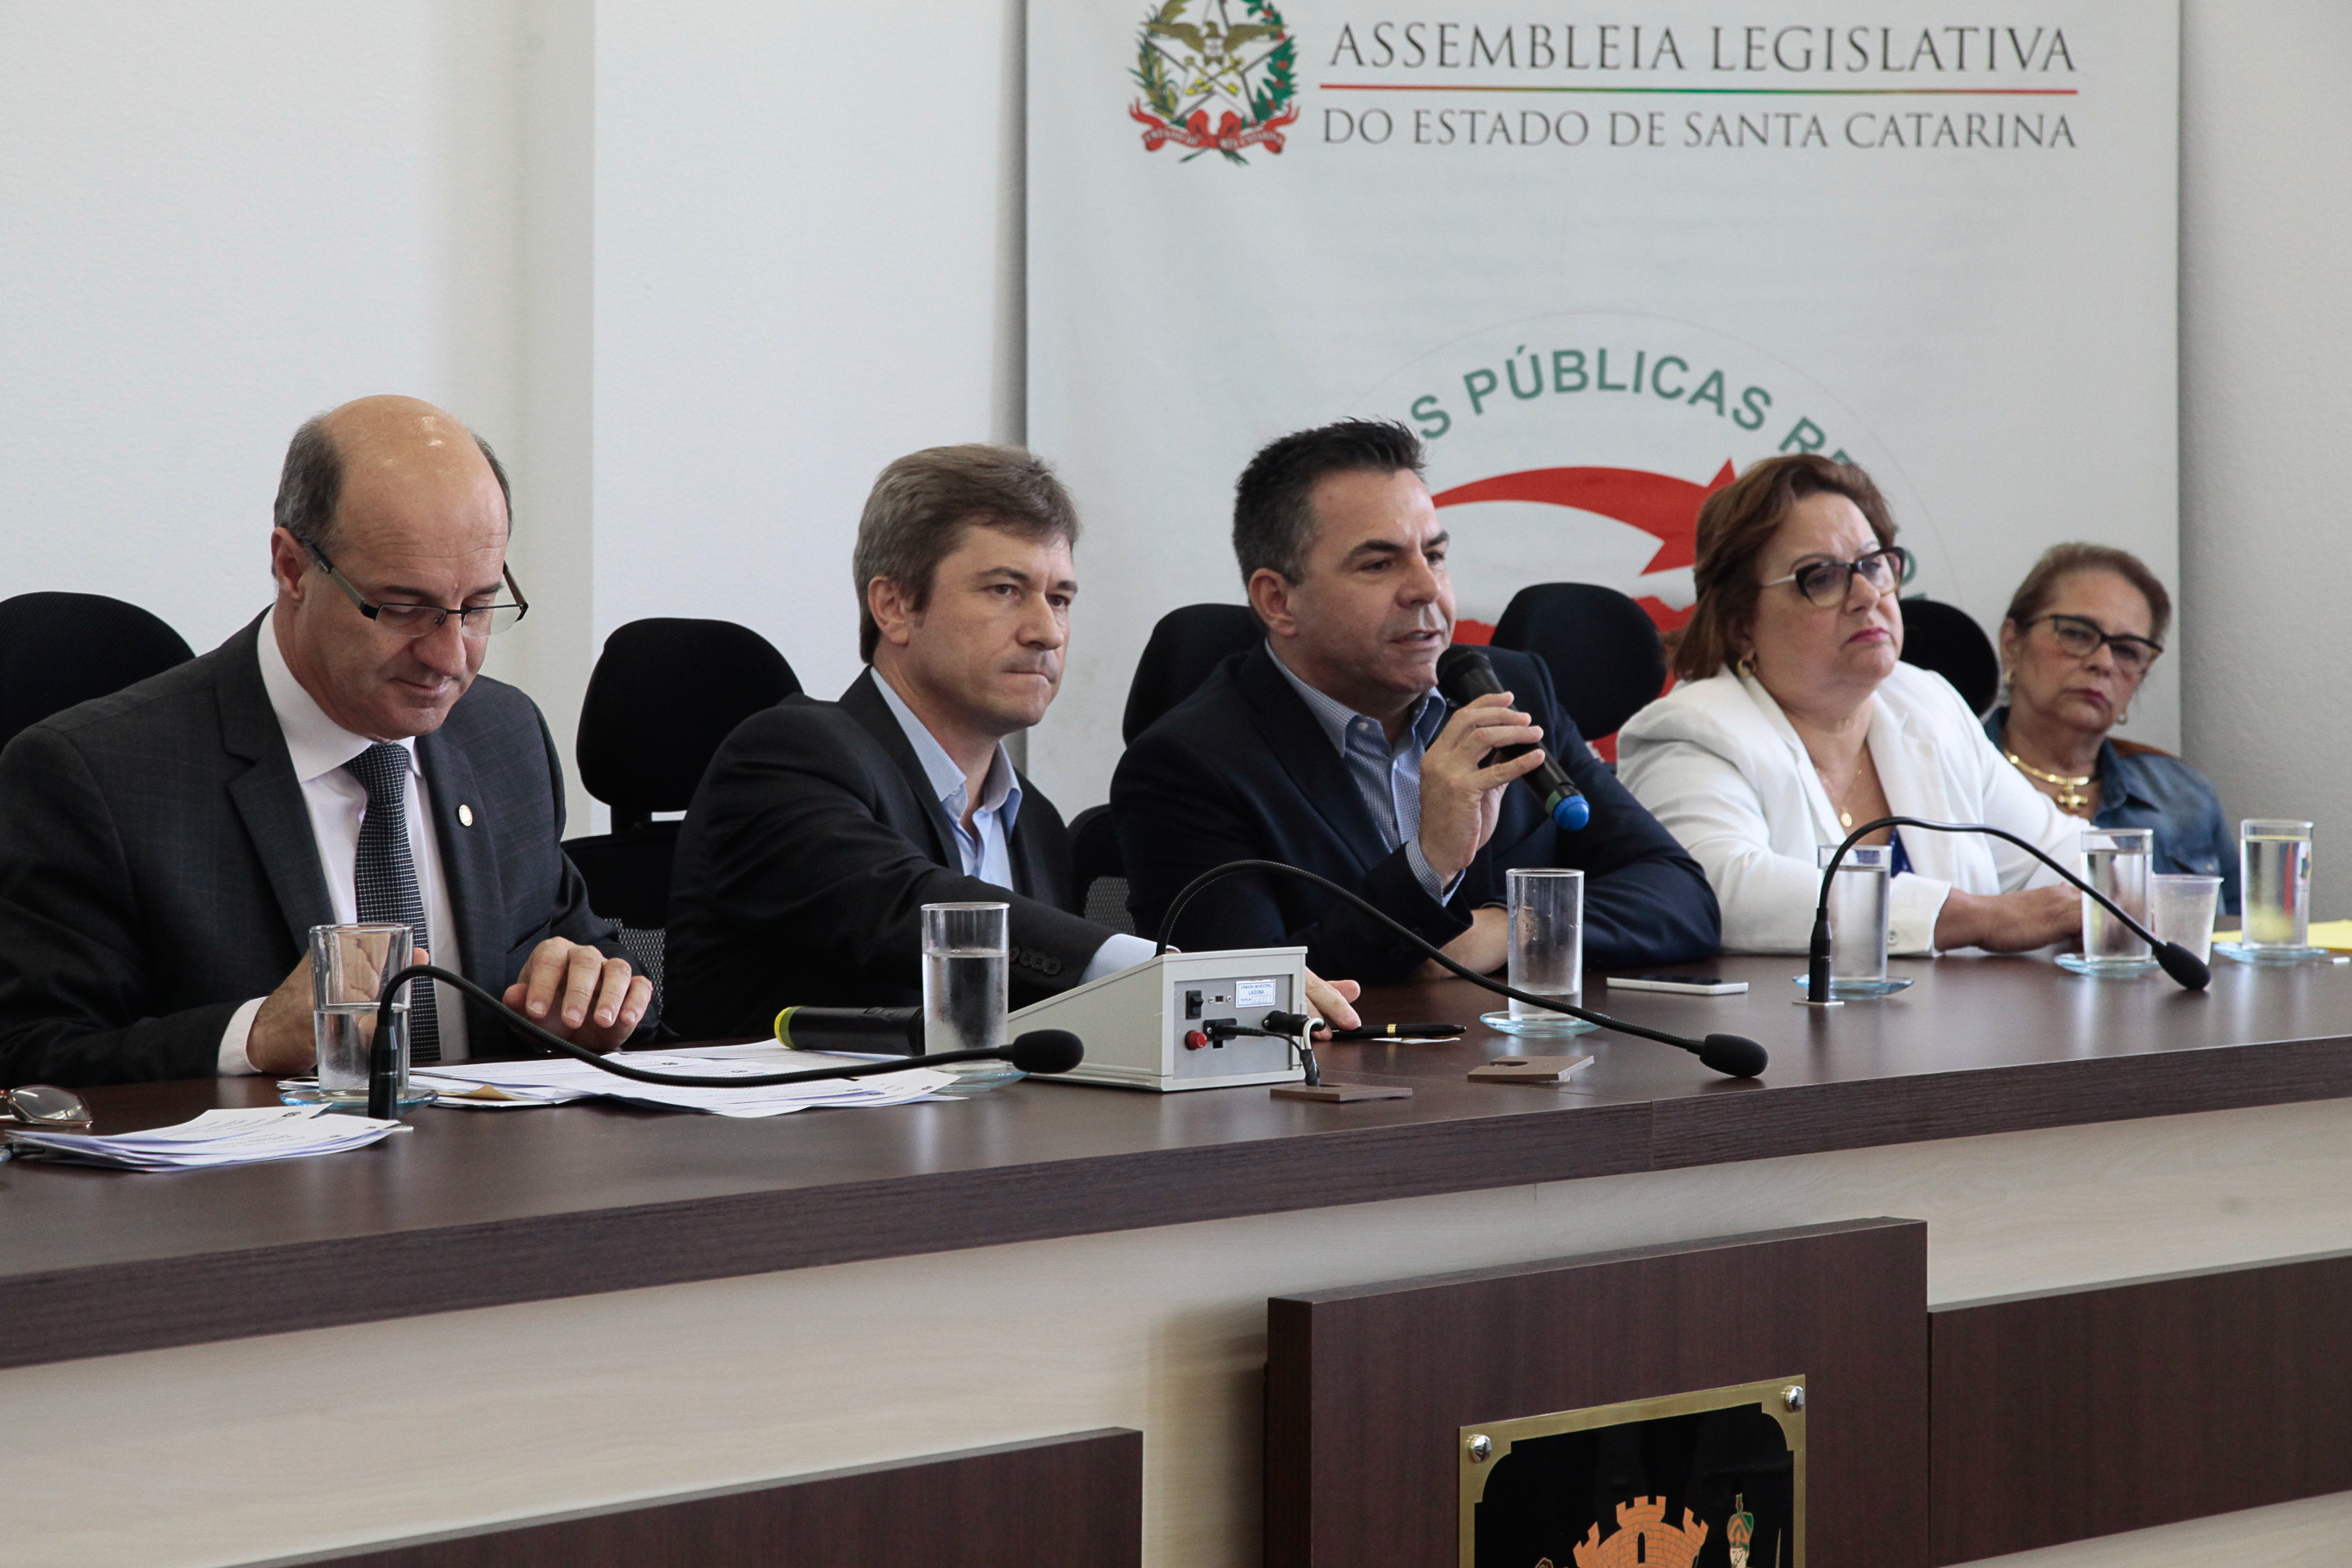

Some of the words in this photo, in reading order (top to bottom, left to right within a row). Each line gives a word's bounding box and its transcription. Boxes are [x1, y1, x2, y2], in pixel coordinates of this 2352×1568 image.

[1328, 22, 1685, 70] ASSEMBLEIA
[1710, 25, 2078, 72] LEGISLATIVA
[1323, 108, 1393, 145] DO
[1414, 109, 1591, 146] ESTADO
[1609, 111, 1666, 147] DE
[1685, 112, 1828, 148] SANTA
[1844, 112, 2077, 149] CATARINA
[1462, 344, 1772, 434] PÚBLICAS
